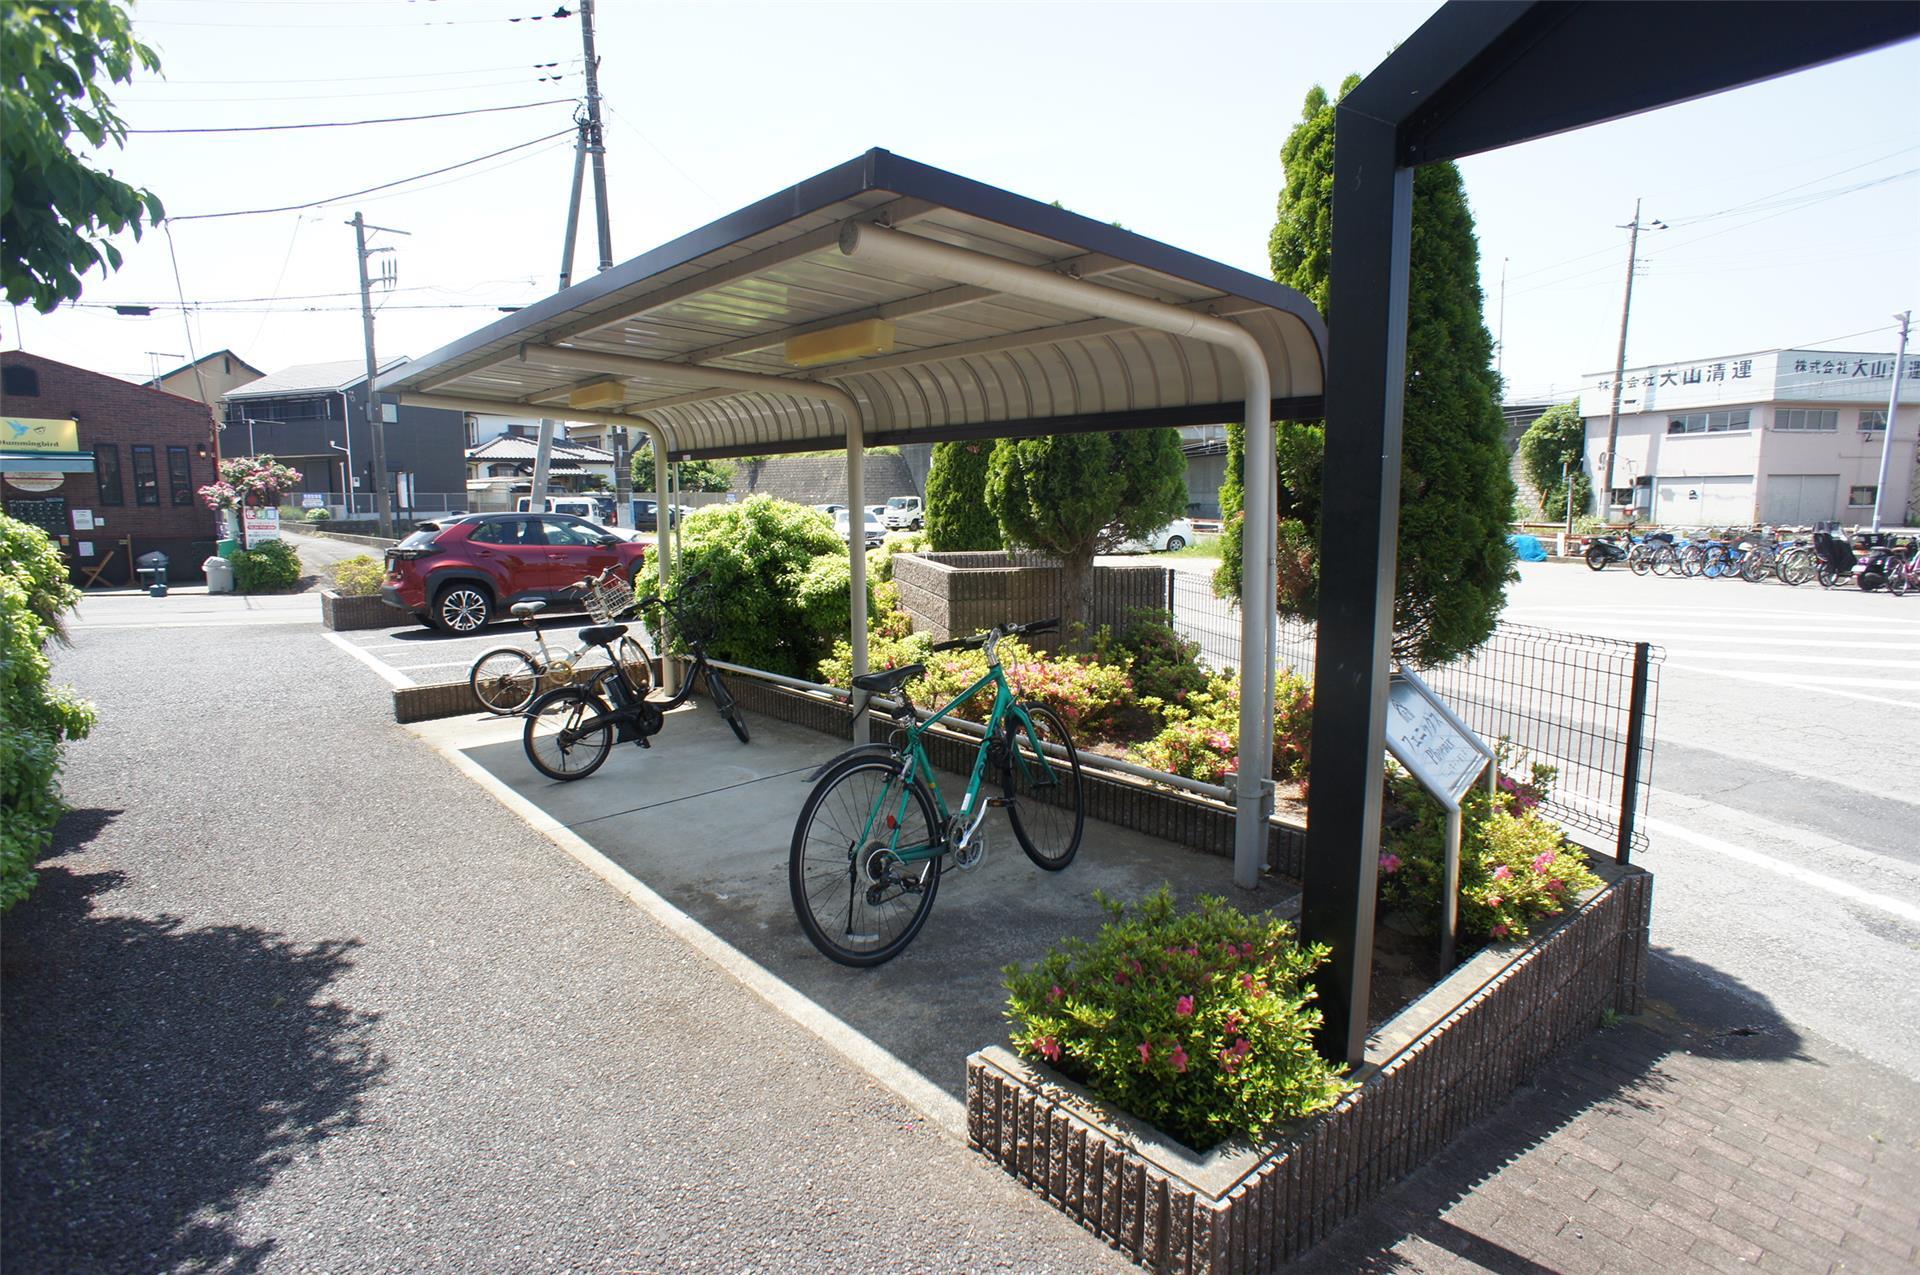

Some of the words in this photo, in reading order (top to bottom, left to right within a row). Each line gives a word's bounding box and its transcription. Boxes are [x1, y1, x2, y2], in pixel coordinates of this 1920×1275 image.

[1598, 359, 1752, 391] 株会社大山清運
